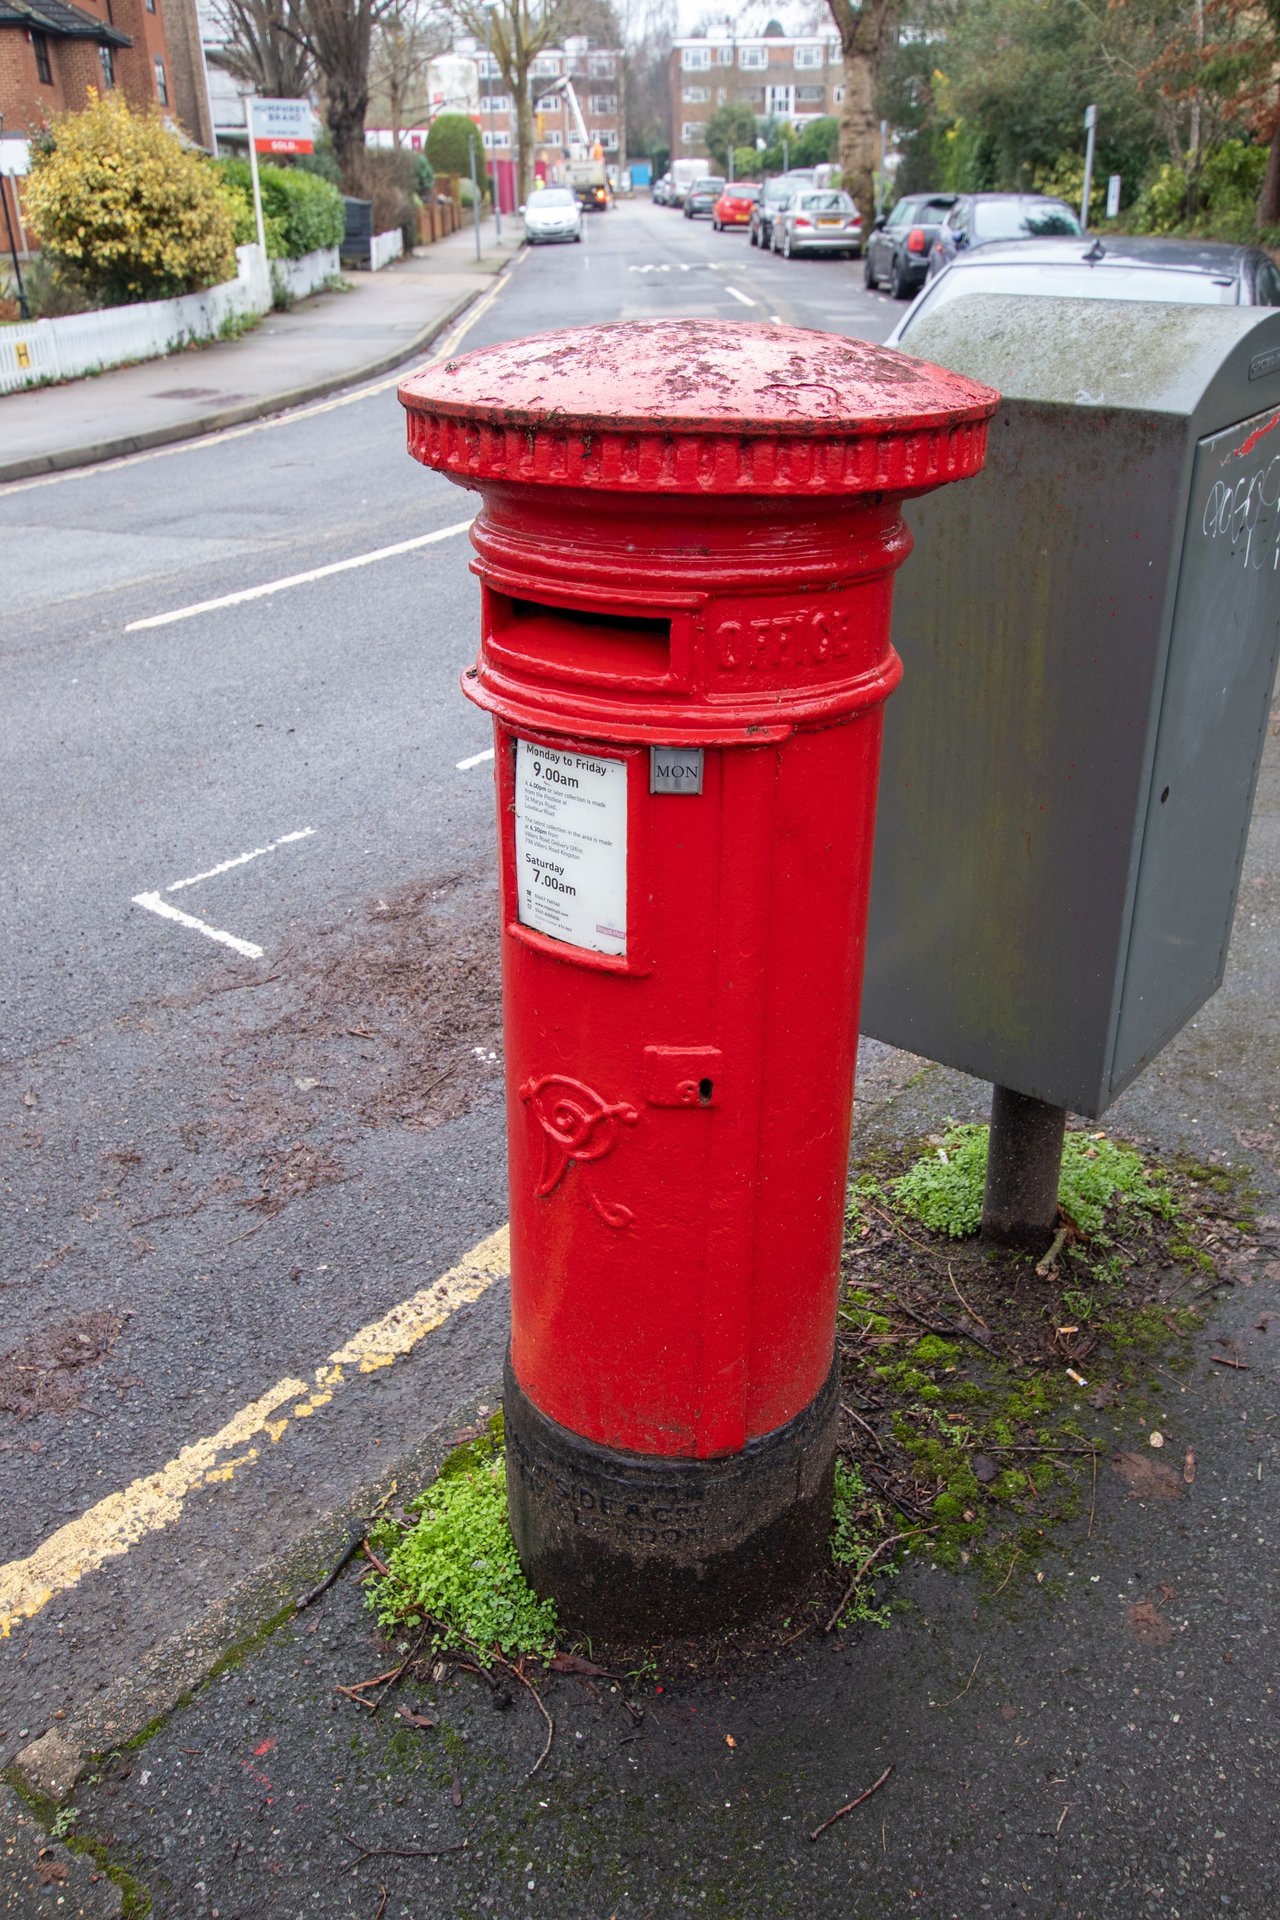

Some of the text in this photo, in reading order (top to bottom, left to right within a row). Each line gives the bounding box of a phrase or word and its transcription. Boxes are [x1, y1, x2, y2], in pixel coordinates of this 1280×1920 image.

[271, 140, 296, 150] SOLD
[526, 744, 607, 776] Monday to Friday
[533, 762, 579, 788] 9.00am
[657, 766, 698, 778] MON
[564, 791, 586, 802] collection
[592, 800, 606, 808] made
[534, 819, 546, 827] latest
[546, 823, 566, 834] collection
[539, 835, 550, 843] Road
[551, 839, 569, 850] Delivery
[526, 853, 564, 875] Saturday
[533, 868, 576, 896] 7.00am
